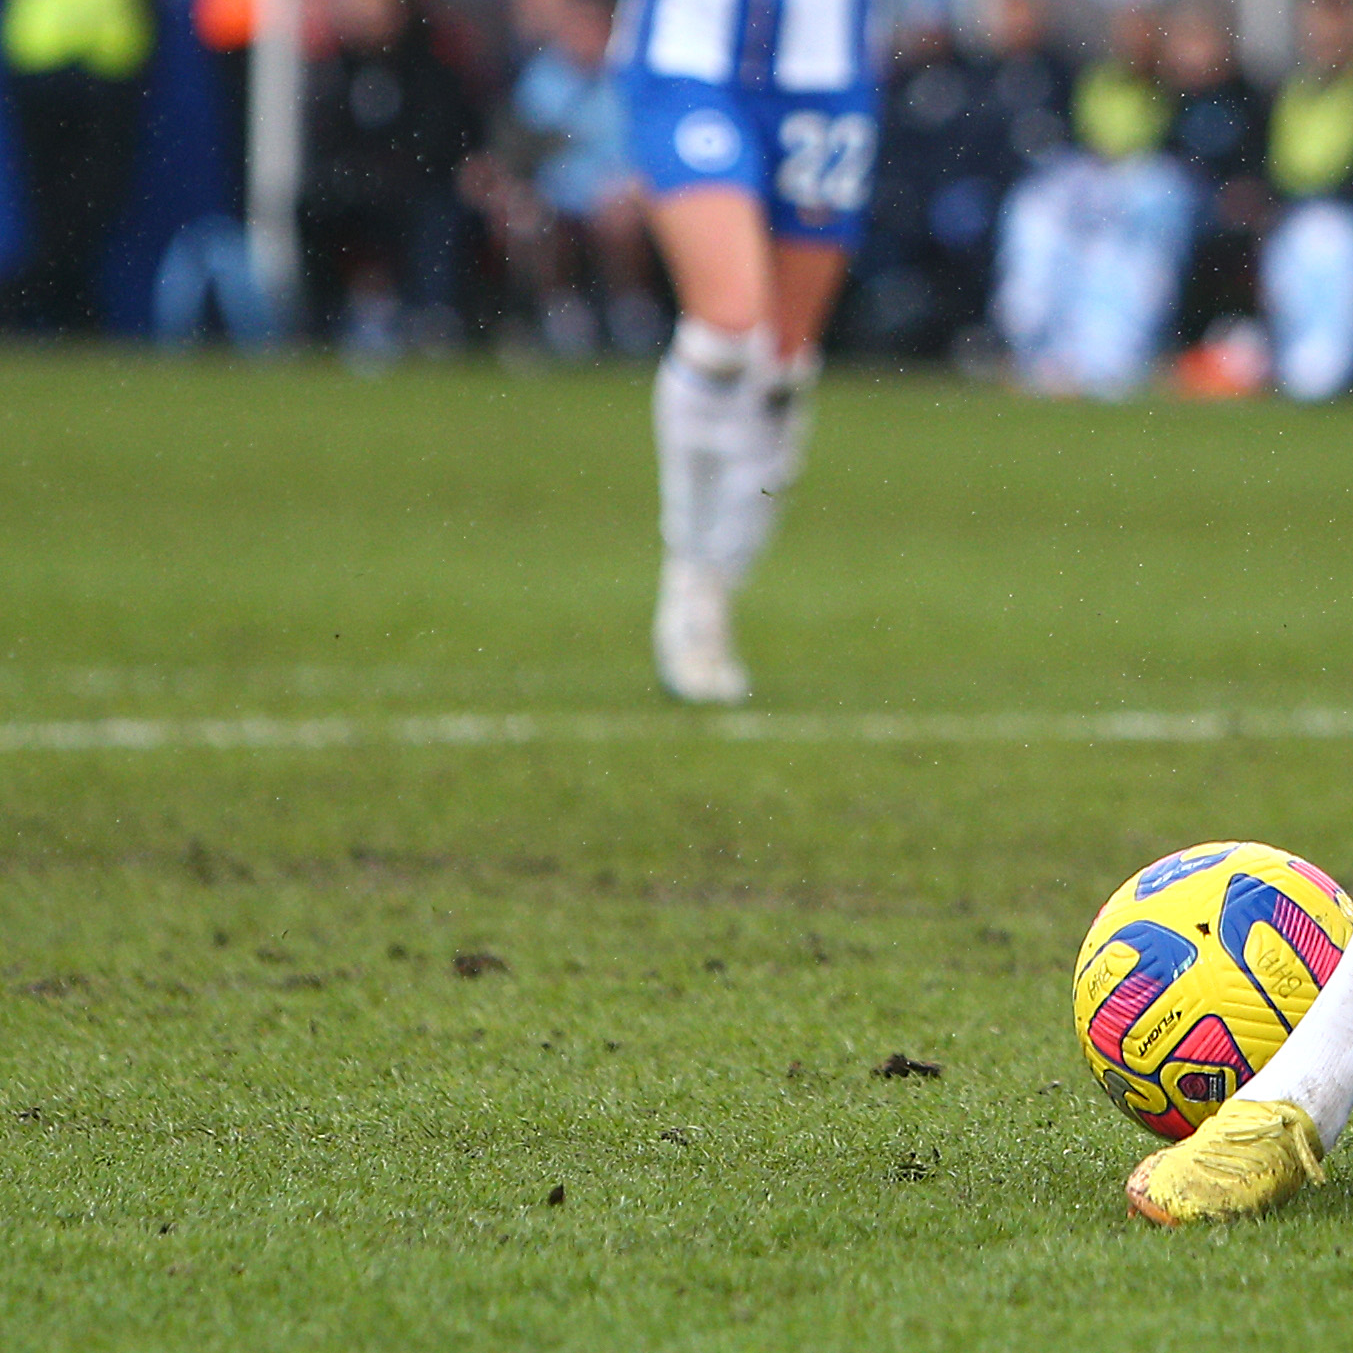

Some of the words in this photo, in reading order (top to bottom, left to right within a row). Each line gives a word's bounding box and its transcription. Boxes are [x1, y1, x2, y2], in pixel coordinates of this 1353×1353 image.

[777, 110, 877, 212] 22
[1257, 948, 1303, 999] BHA
[1137, 1008, 1176, 1058] FLIGHT
